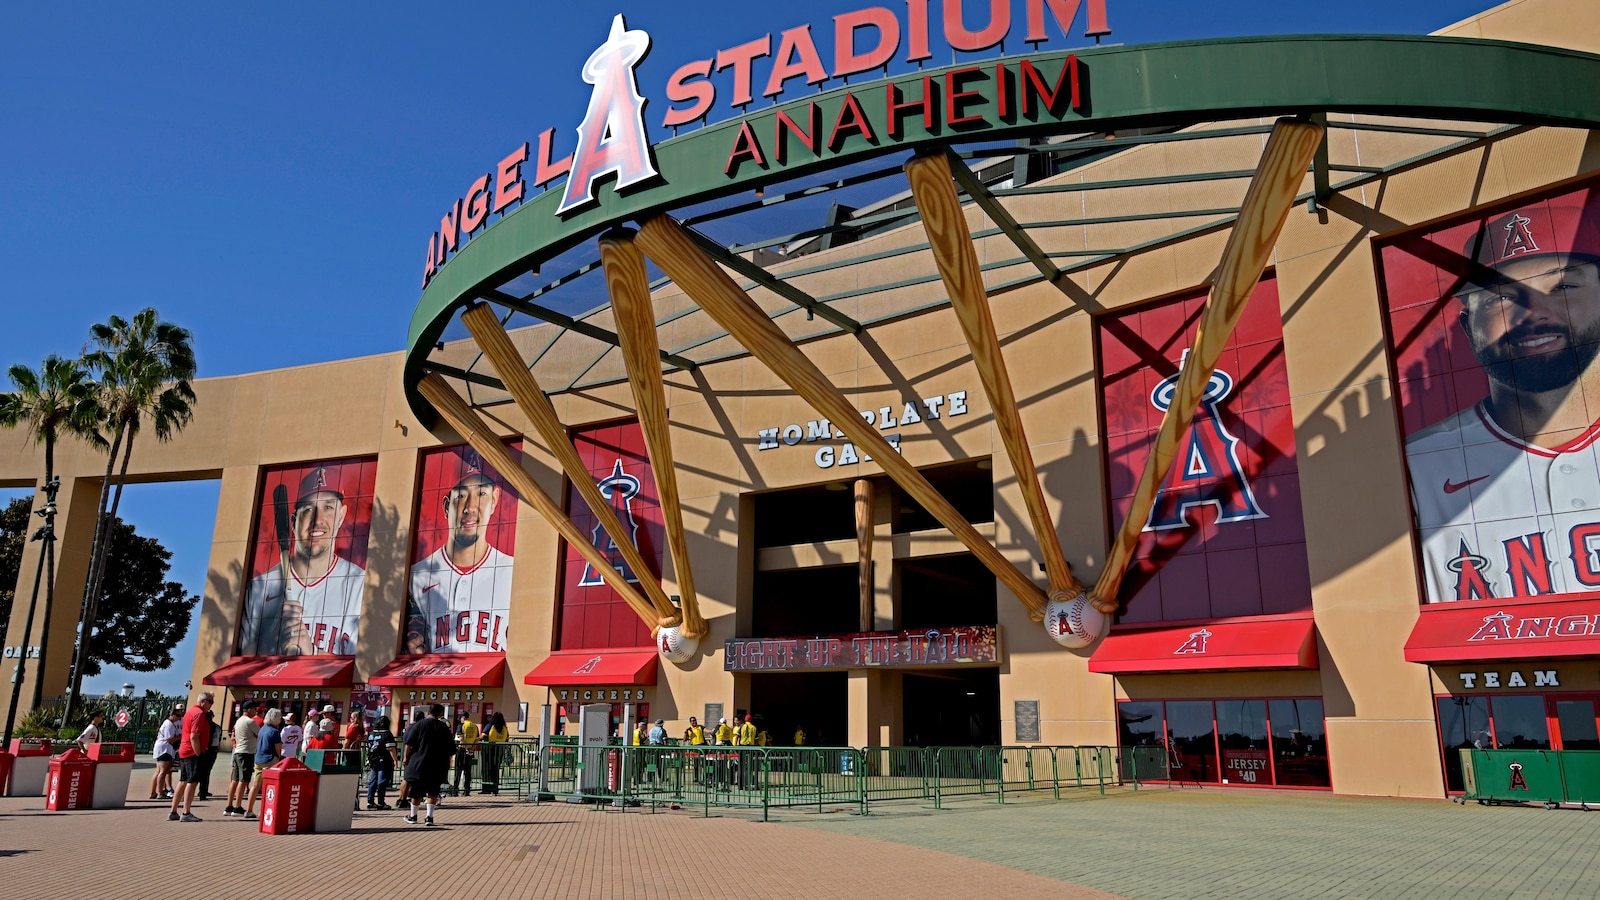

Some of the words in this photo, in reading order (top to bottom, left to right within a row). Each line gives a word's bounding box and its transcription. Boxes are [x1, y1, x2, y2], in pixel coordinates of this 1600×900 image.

[724, 53, 1092, 180] ANAHEIM
[421, 127, 574, 290] ANGEL
[662, 0, 1112, 128] STADIUM
[1467, 611, 1600, 641] ANG
[807, 639, 841, 667] UP
[852, 635, 900, 665] THE
[906, 629, 972, 664] HALO
[1173, 629, 1212, 655] A
[1459, 670, 1560, 689] TEAM
[252, 690, 321, 700] TICKETS
[409, 691, 485, 701] TICKETS
[560, 690, 645, 701] TICKETS
[118, 711, 126, 724] 2
[284, 734, 299, 744] 27
[1227, 759, 1267, 770] JERSEY
[1509, 760, 1530, 791] A
[67, 770, 81, 809] RECYCLE
[287, 784, 301, 833] RECYCLE
